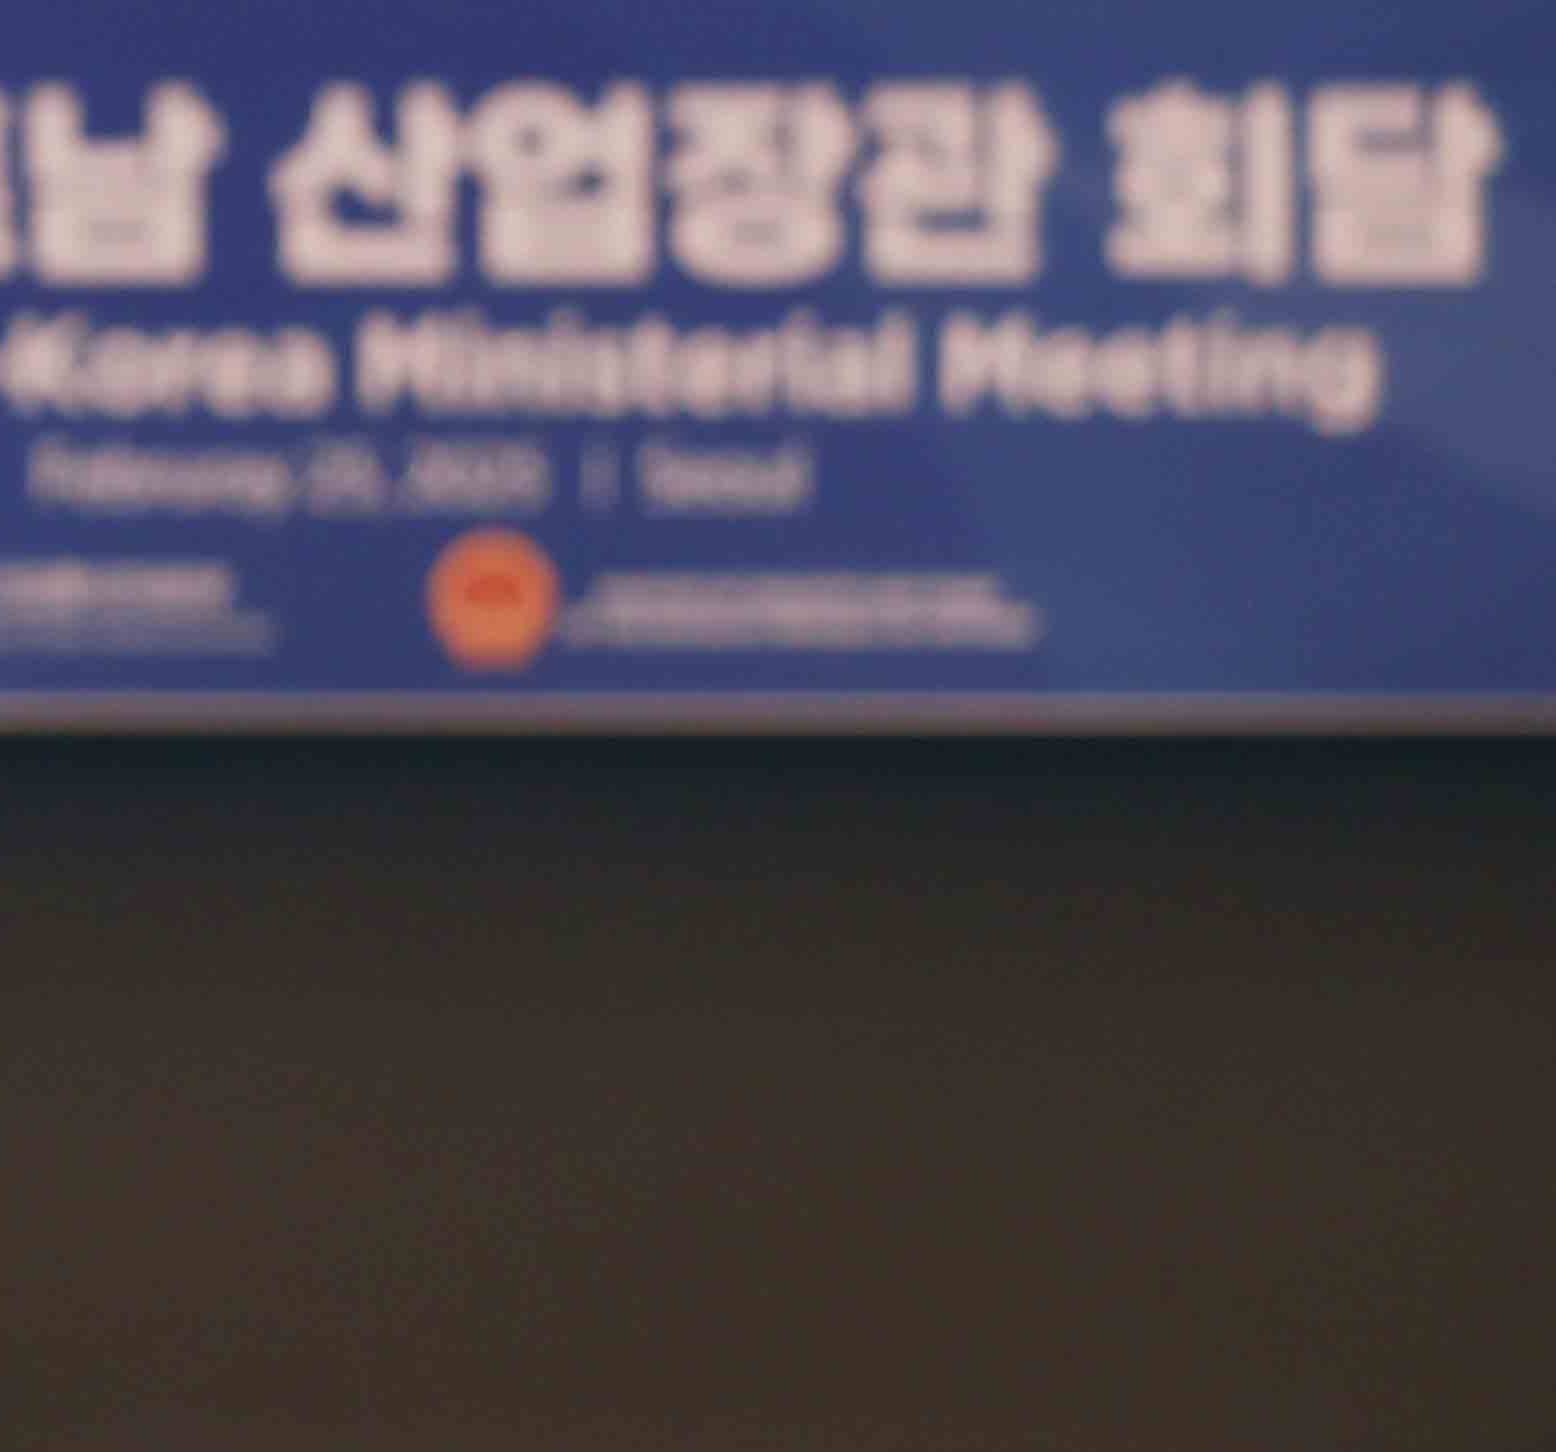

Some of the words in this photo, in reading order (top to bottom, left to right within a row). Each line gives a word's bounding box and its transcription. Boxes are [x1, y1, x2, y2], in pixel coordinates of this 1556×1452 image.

[270, 83, 1057, 286] 산업장관
[1105, 83, 1501, 287] 회담
[356, 314, 916, 413] Ministerial
[938, 314, 1381, 432] Meeting
